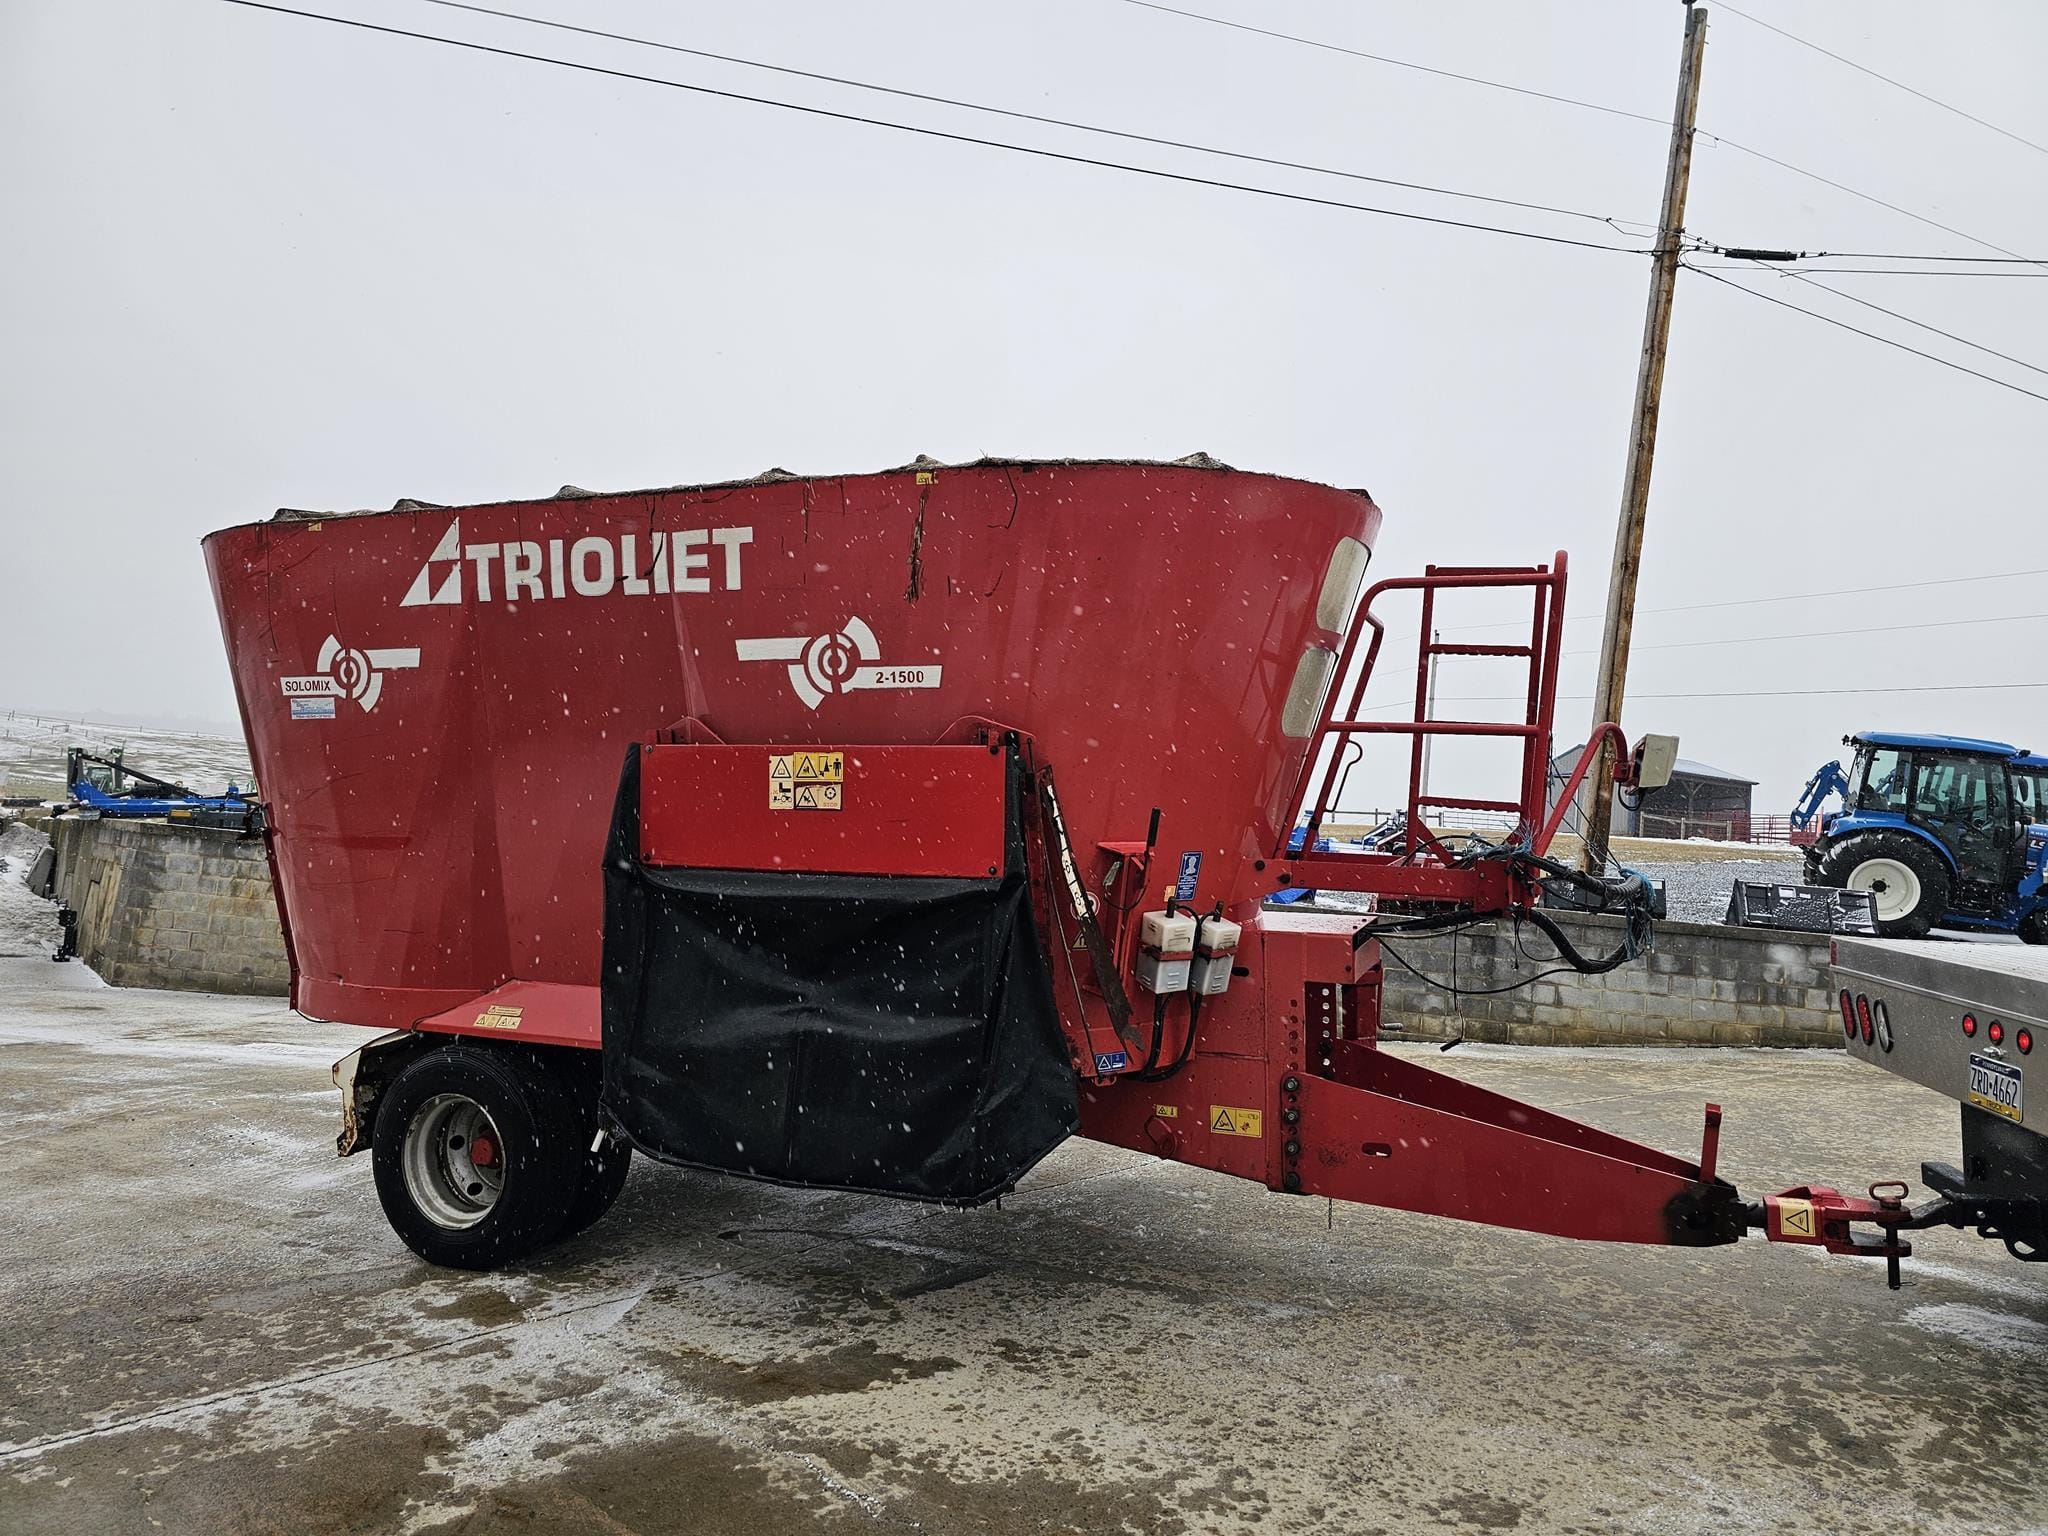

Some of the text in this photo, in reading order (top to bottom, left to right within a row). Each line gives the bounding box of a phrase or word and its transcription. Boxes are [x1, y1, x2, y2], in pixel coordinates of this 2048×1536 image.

[465, 526, 753, 602] TRIOLIET
[875, 670, 924, 684] 2-1500
[285, 680, 331, 692] SOLOMIX
